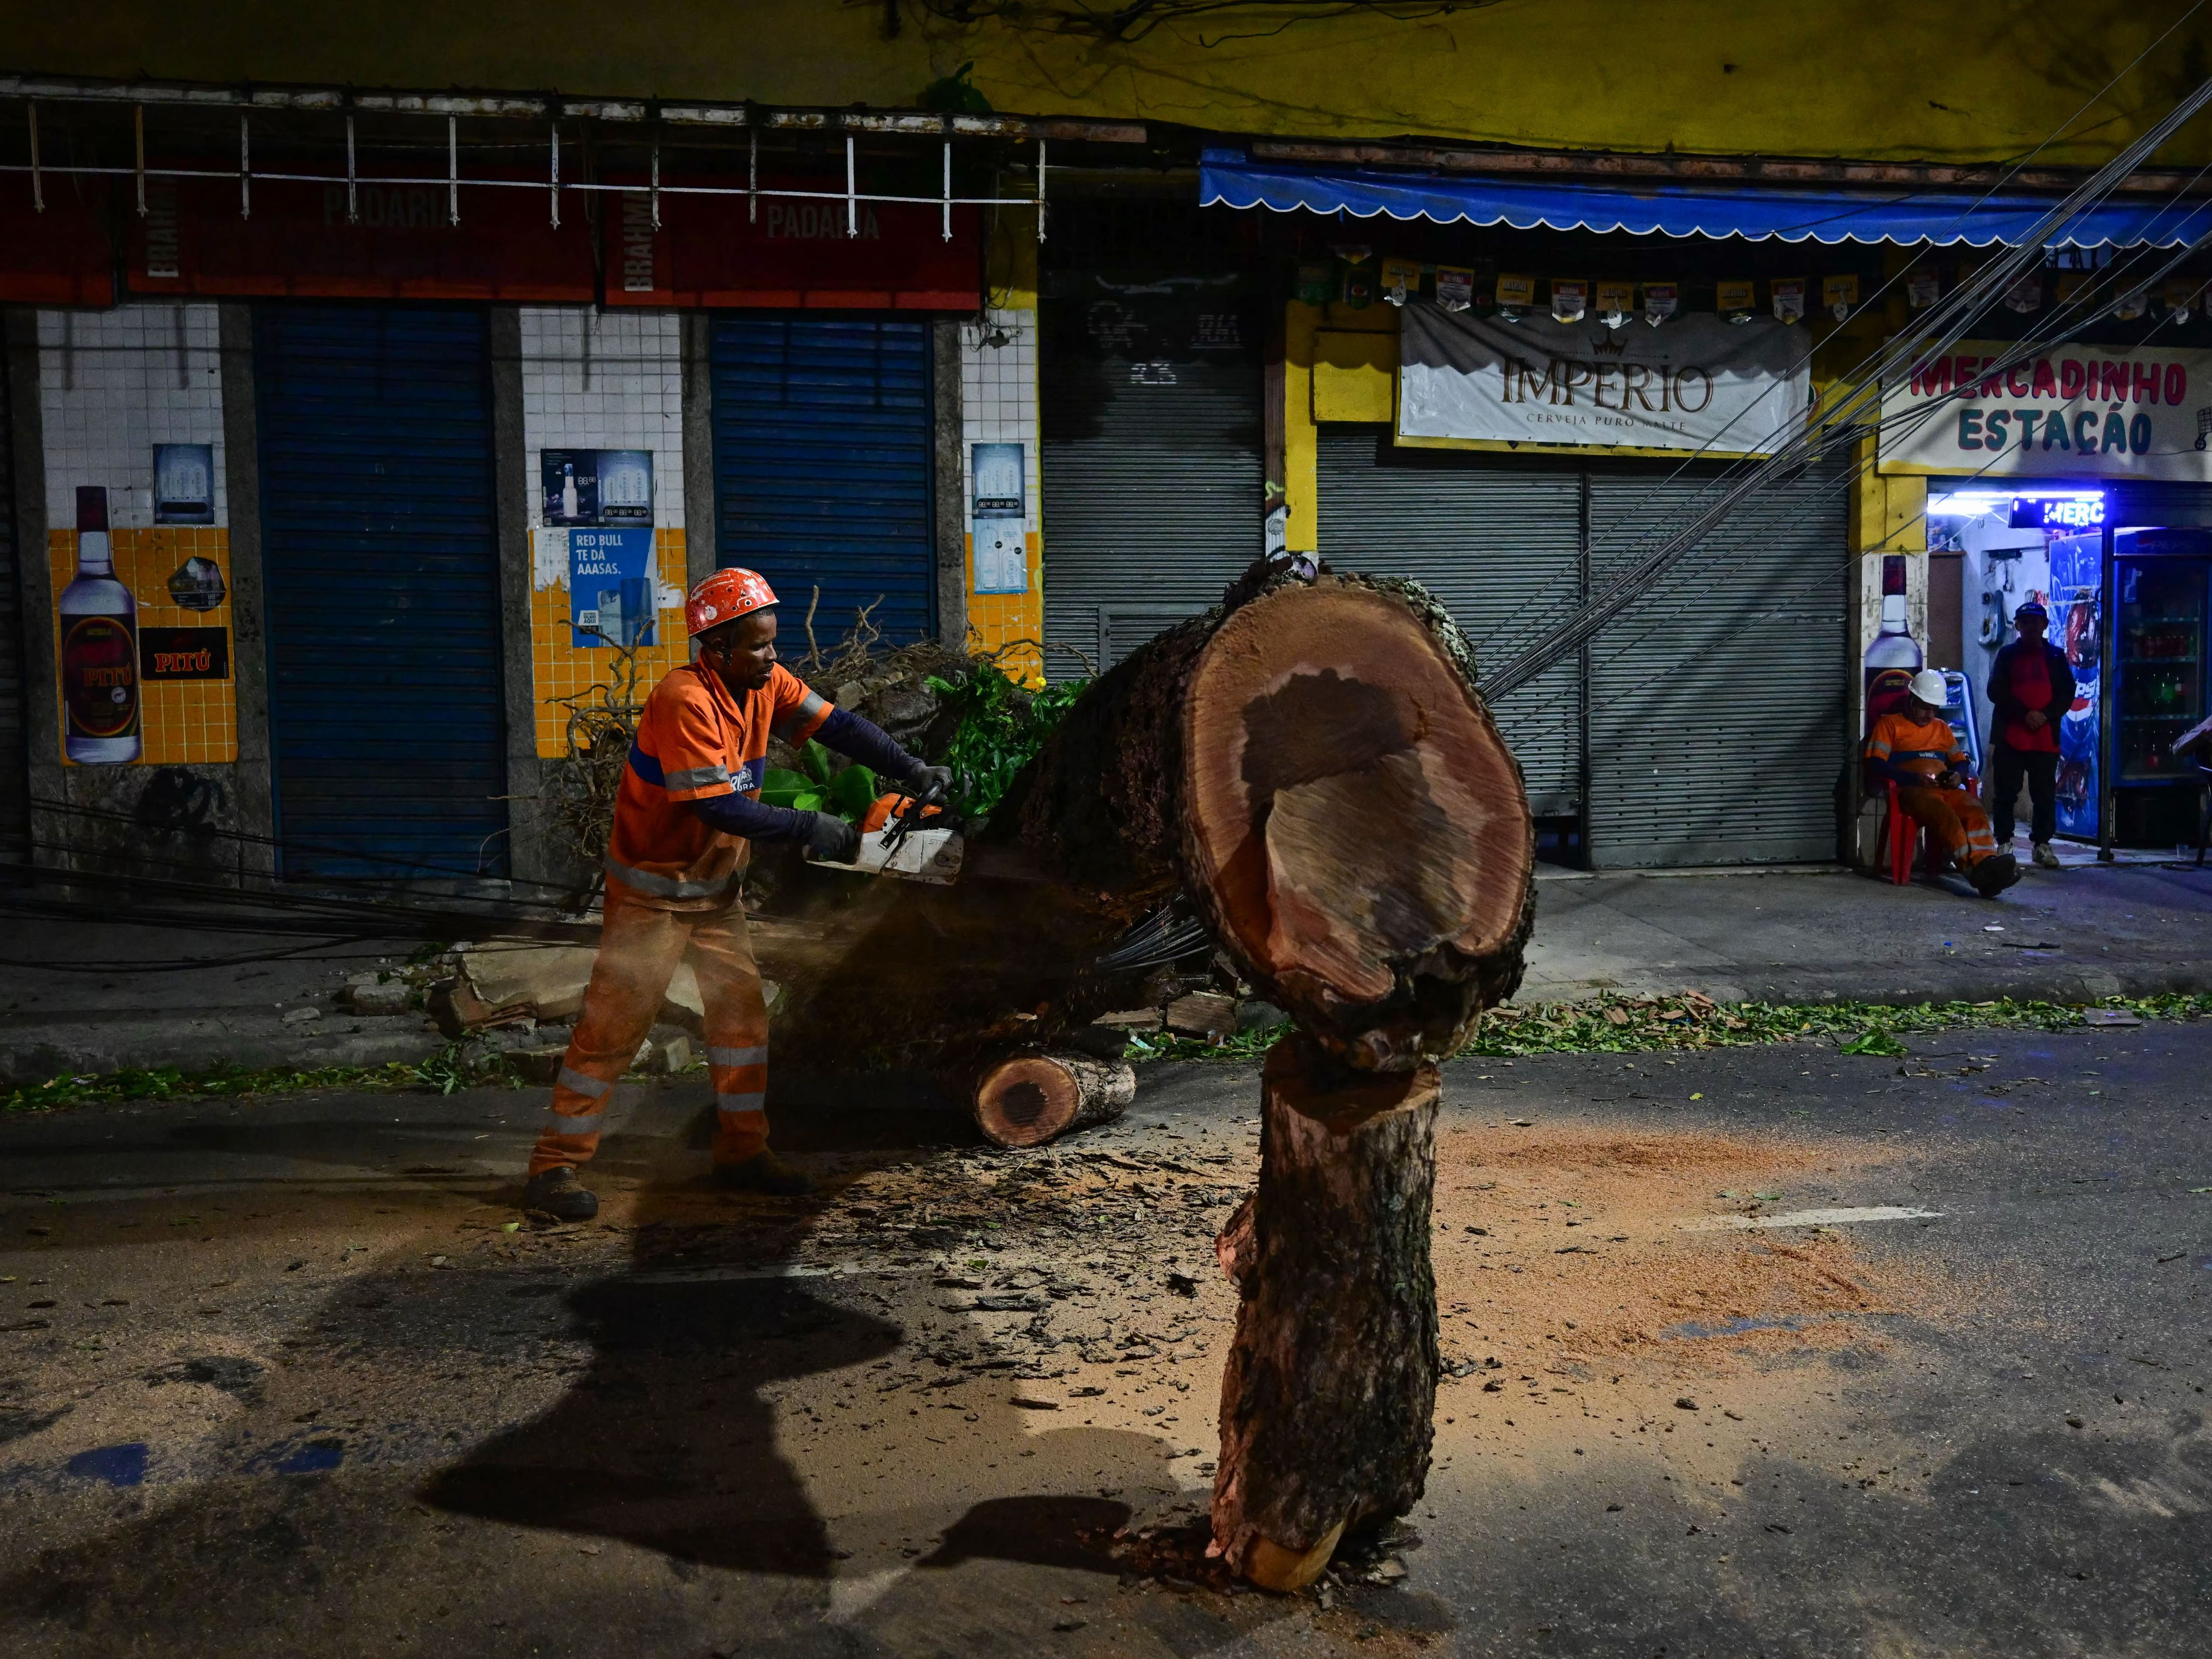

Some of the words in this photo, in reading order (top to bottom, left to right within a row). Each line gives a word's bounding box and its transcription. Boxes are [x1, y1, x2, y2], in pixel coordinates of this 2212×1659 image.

[1501, 356, 1714, 413] IMPERIO
[1910, 355, 2187, 406] MERCADINHO
[1527, 413, 1586, 425] CERVEJA
[1595, 416, 1634, 427] PURO
[1958, 402, 2152, 455] ESTAÇÃO
[577, 534, 596, 546] RED
[599, 534, 623, 545] BULL
[576, 549, 588, 561] TE
[591, 546, 605, 560] DÁ
[578, 563, 621, 575] AAASAS.
[154, 648, 211, 672] PITÚ
[83, 662, 133, 687] PITÚ
